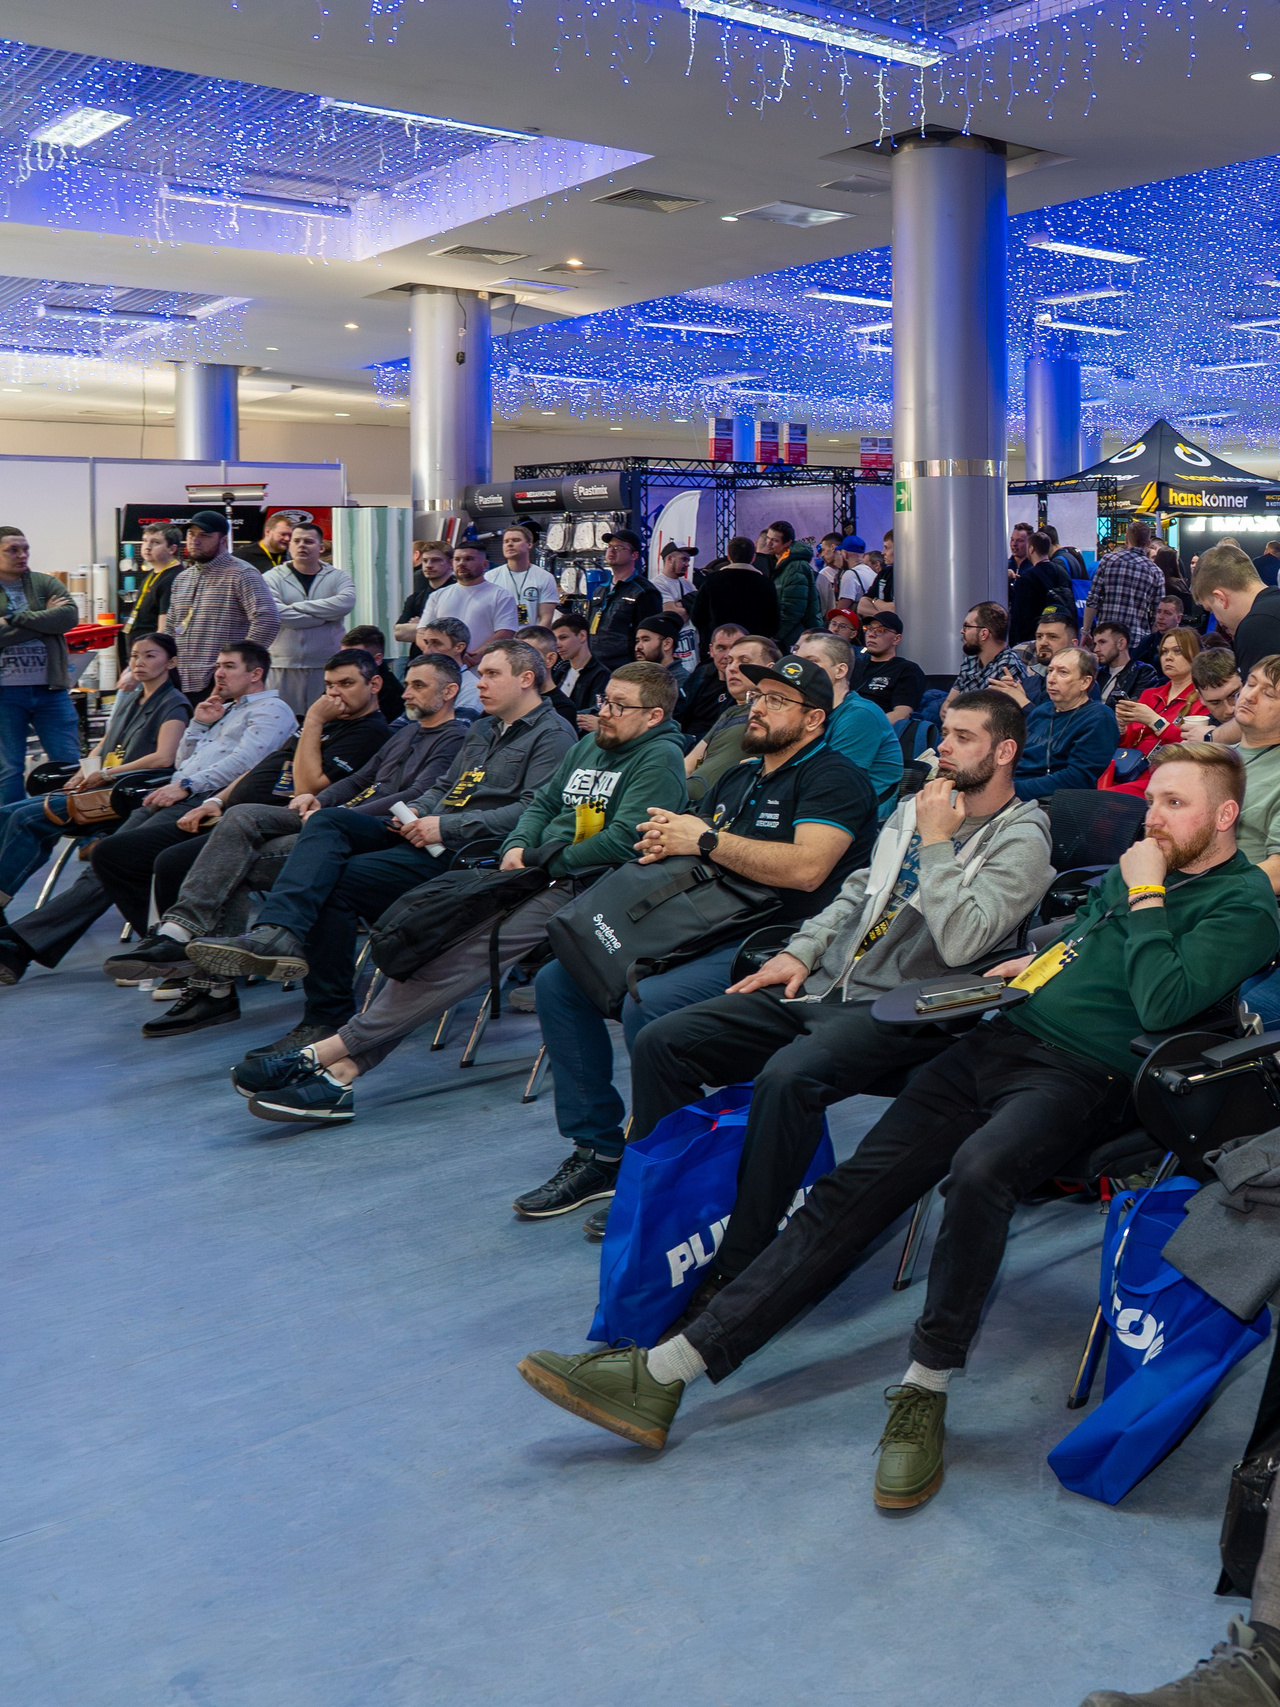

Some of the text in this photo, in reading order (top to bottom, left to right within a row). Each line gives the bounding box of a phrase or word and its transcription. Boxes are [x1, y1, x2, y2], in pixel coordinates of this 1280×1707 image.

[578, 485, 608, 497] Plastimix
[1169, 488, 1249, 508] hanskonner
[595, 930, 615, 954] electric
